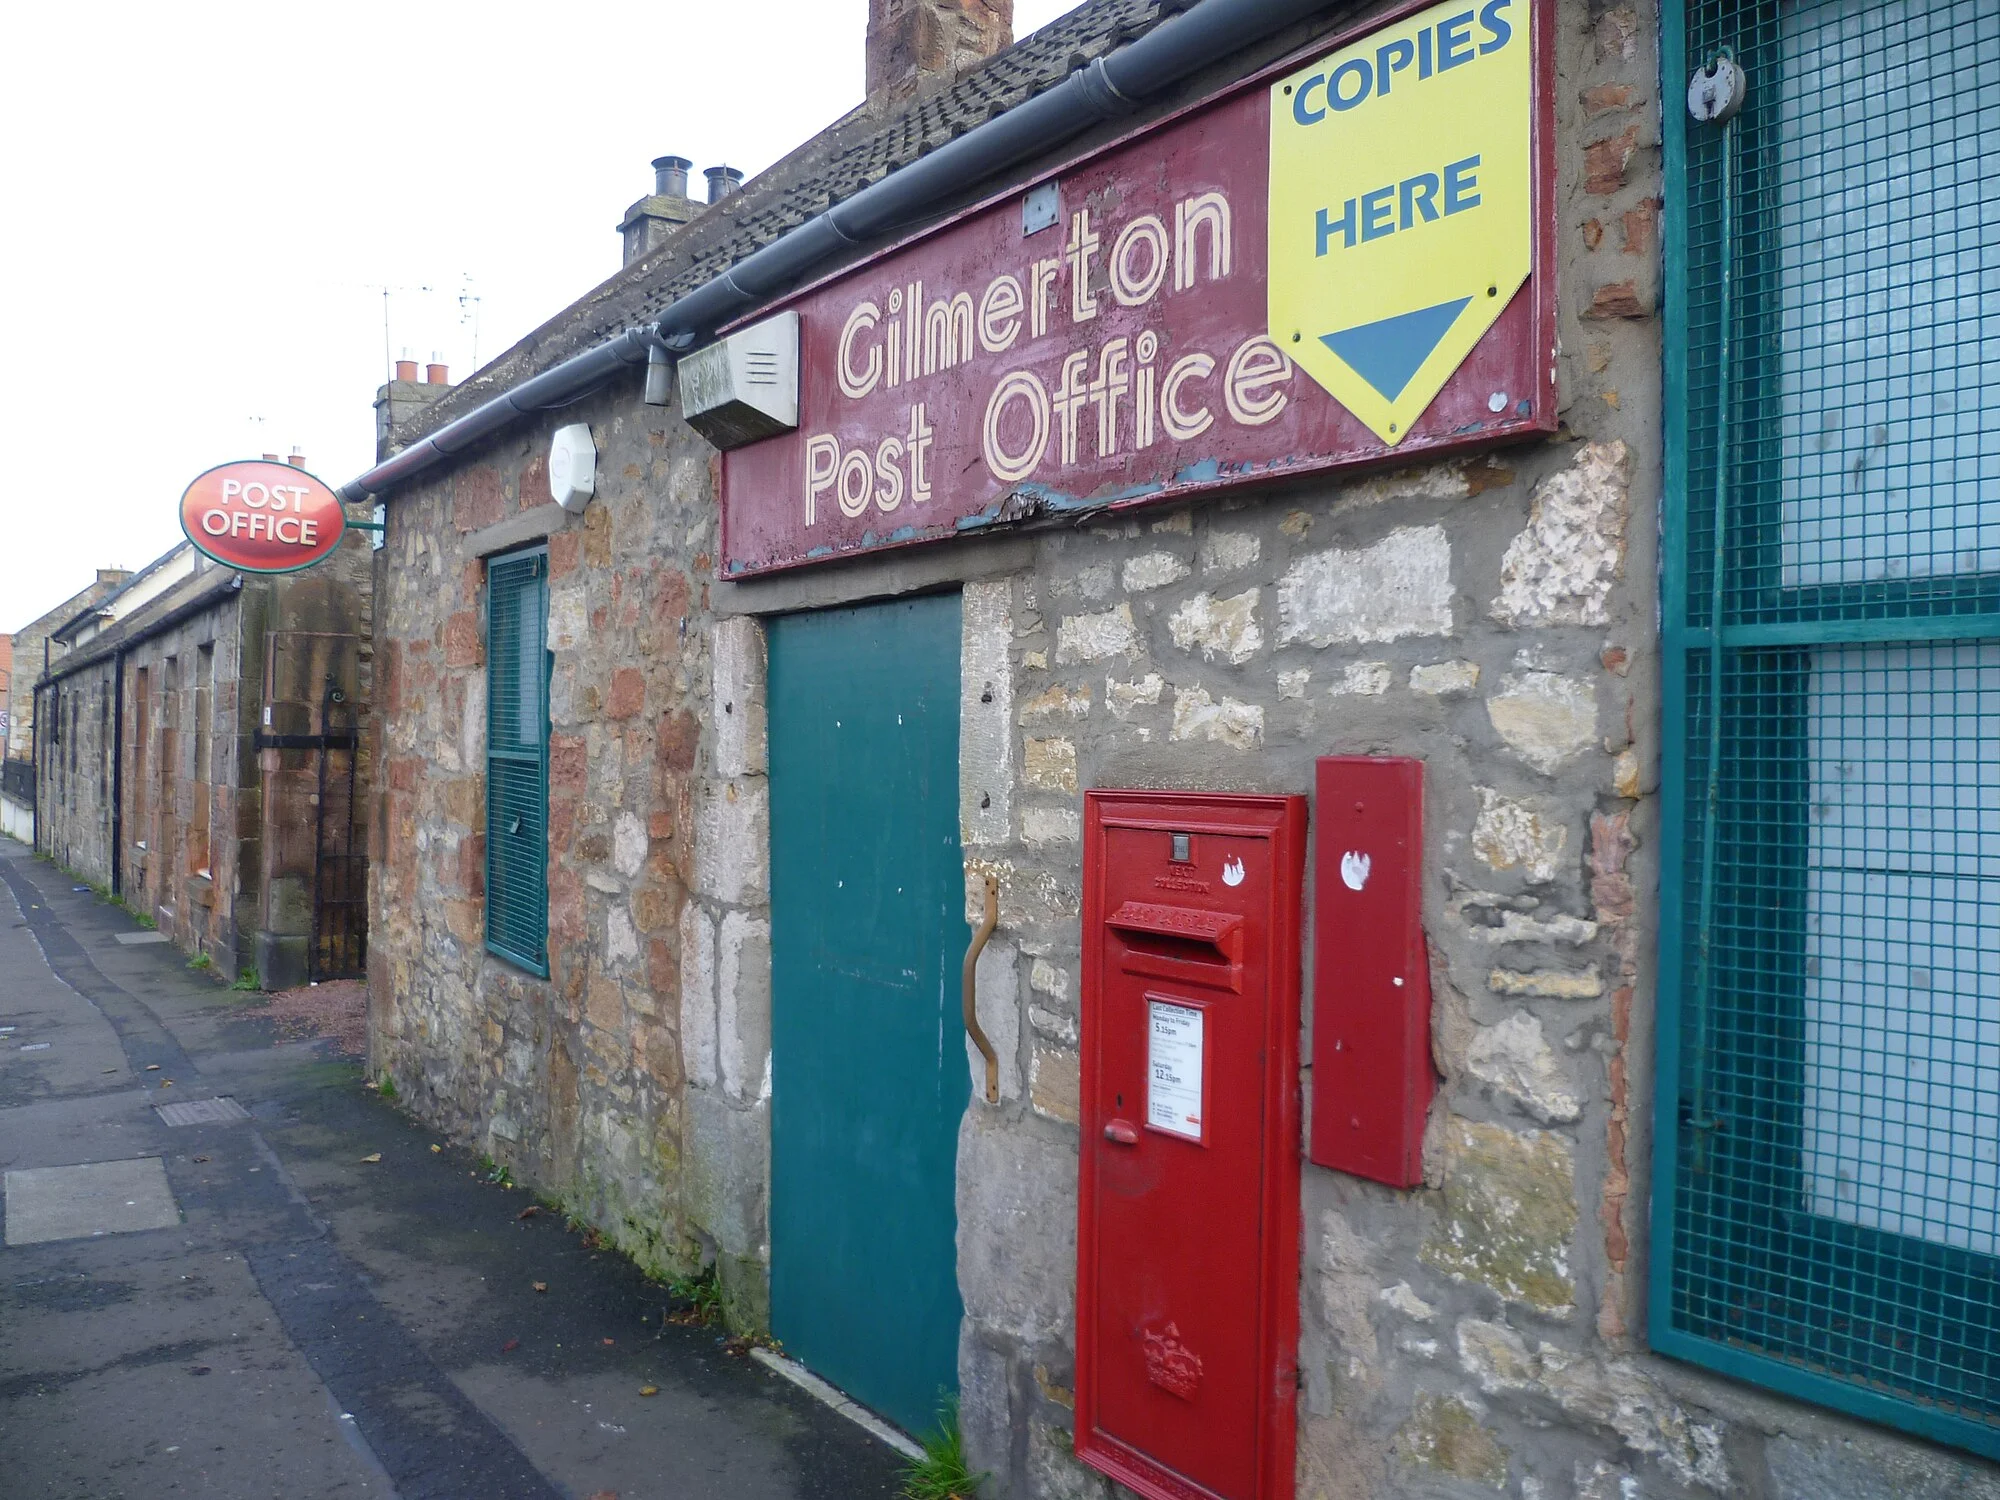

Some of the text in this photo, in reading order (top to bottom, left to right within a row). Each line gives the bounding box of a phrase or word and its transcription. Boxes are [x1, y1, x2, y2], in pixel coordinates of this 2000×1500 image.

[1292, 0, 1512, 126] COPIES
[1315, 154, 1481, 258] HERE
[838, 192, 1231, 399] Gilmerton
[804, 330, 1293, 526] Post Office
[222, 479, 310, 513] POST
[202, 509, 318, 546] OFFICE
[1152, 1013, 1170, 1023] Monday
[1175, 1017, 1190, 1027] Friday
[1156, 1022, 1176, 1035] 5.15pm
[1152, 1060, 1172, 1071] Saturday
[1155, 1069, 1181, 1083] 12.15pm
